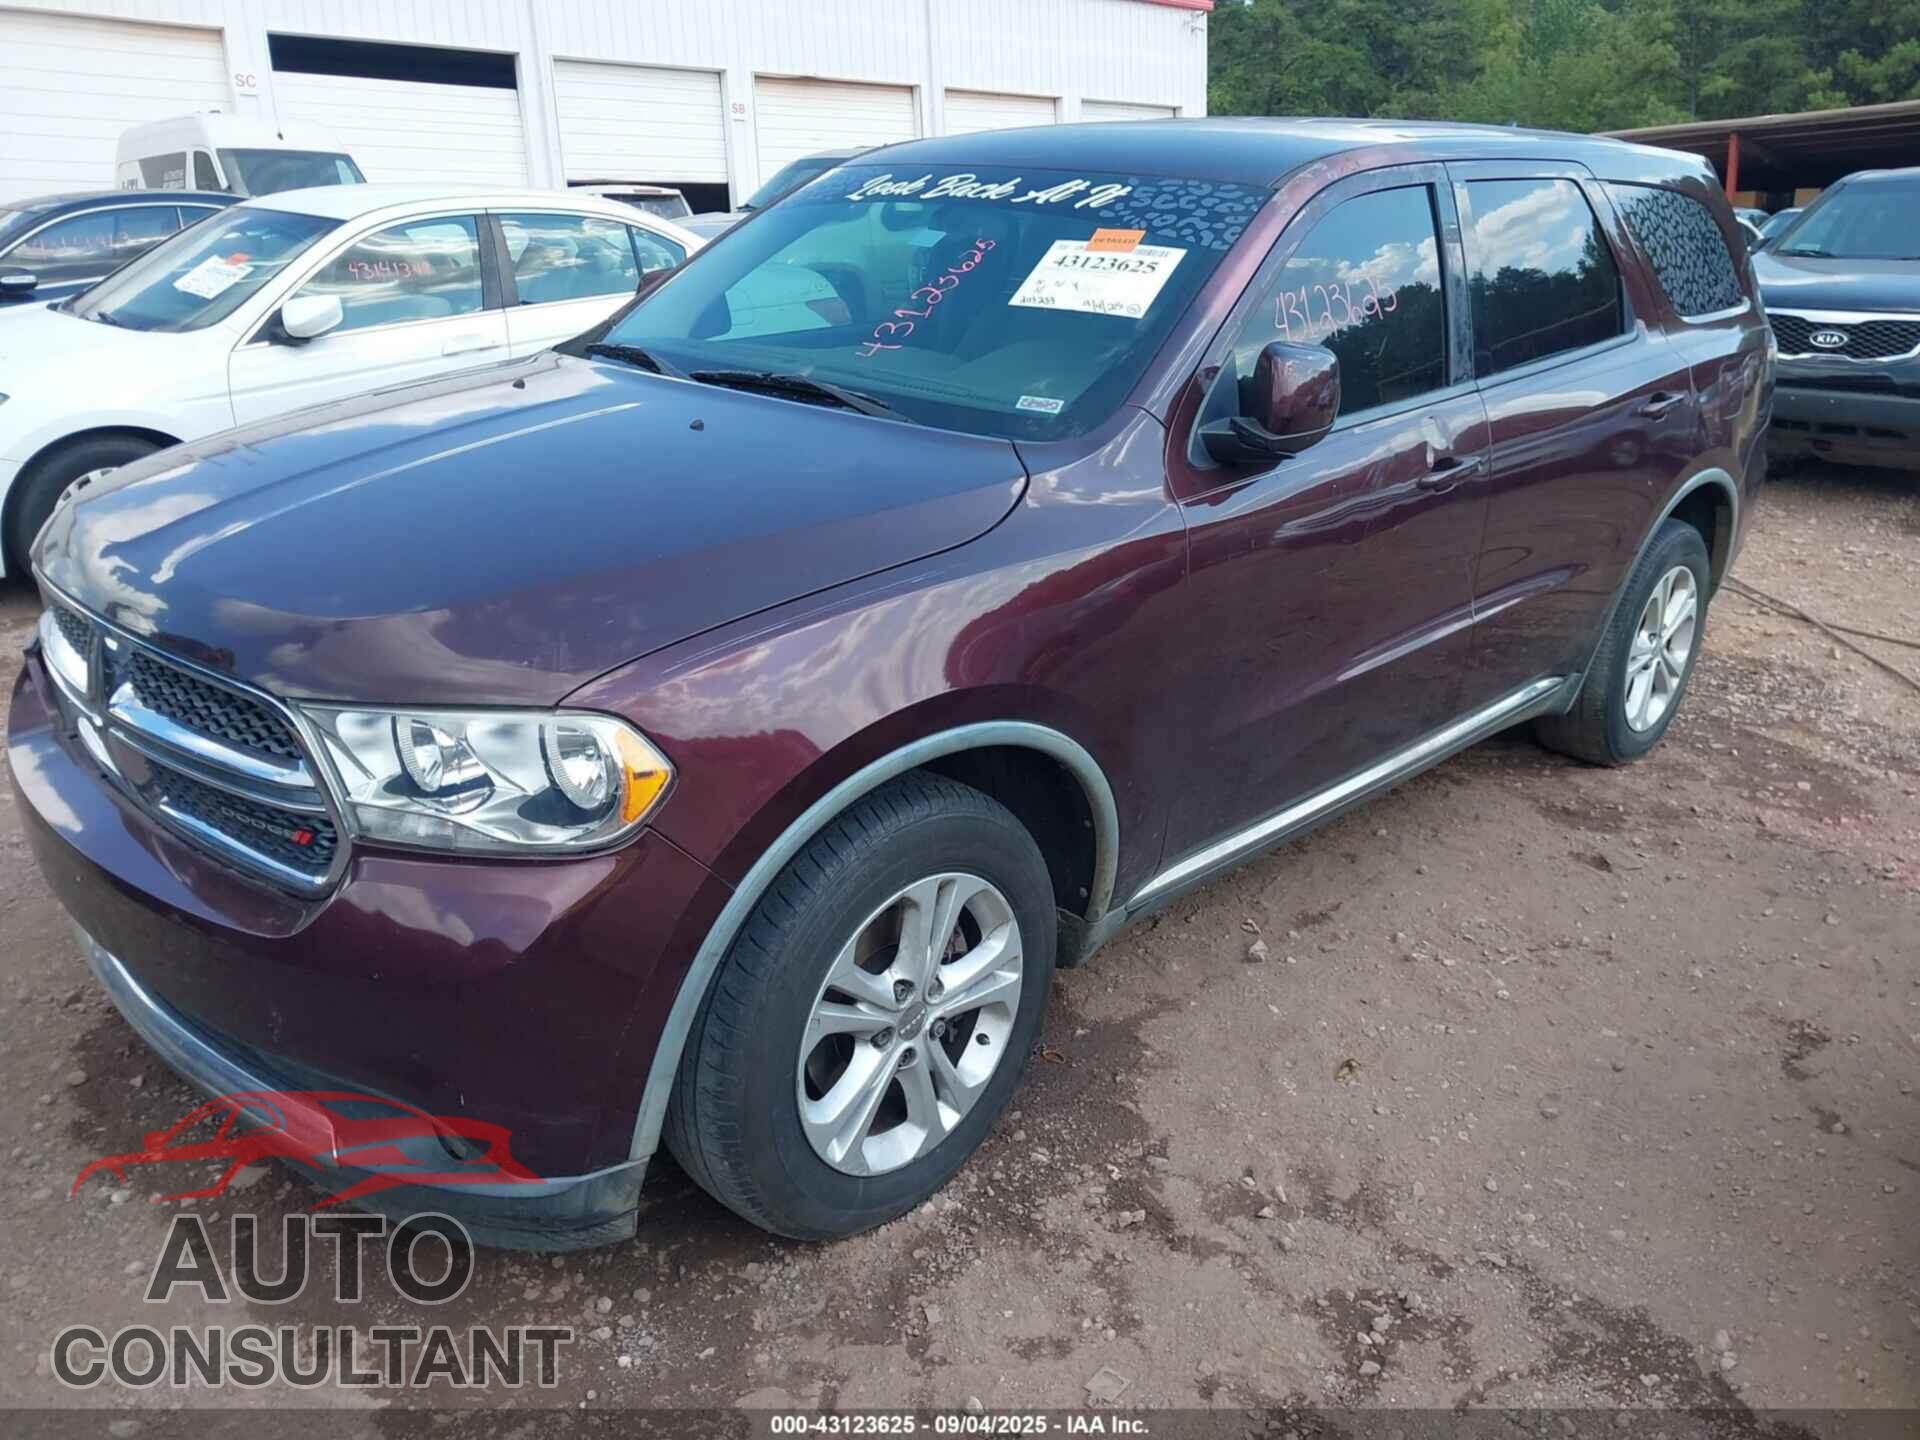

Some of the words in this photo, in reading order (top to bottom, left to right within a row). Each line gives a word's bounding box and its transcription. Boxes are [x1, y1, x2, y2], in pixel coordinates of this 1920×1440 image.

[235, 73, 256, 88] SC
[845, 173, 933, 201] Look
[920, 173, 1023, 201] Back
[1010, 179, 1090, 205] At
[1074, 183, 1133, 209] It
[1053, 255, 1160, 274] 43123625
[856, 238, 997, 357] 43123625
[1274, 276, 1398, 339] 43123625
[1816, 334, 1840, 344] KIA
